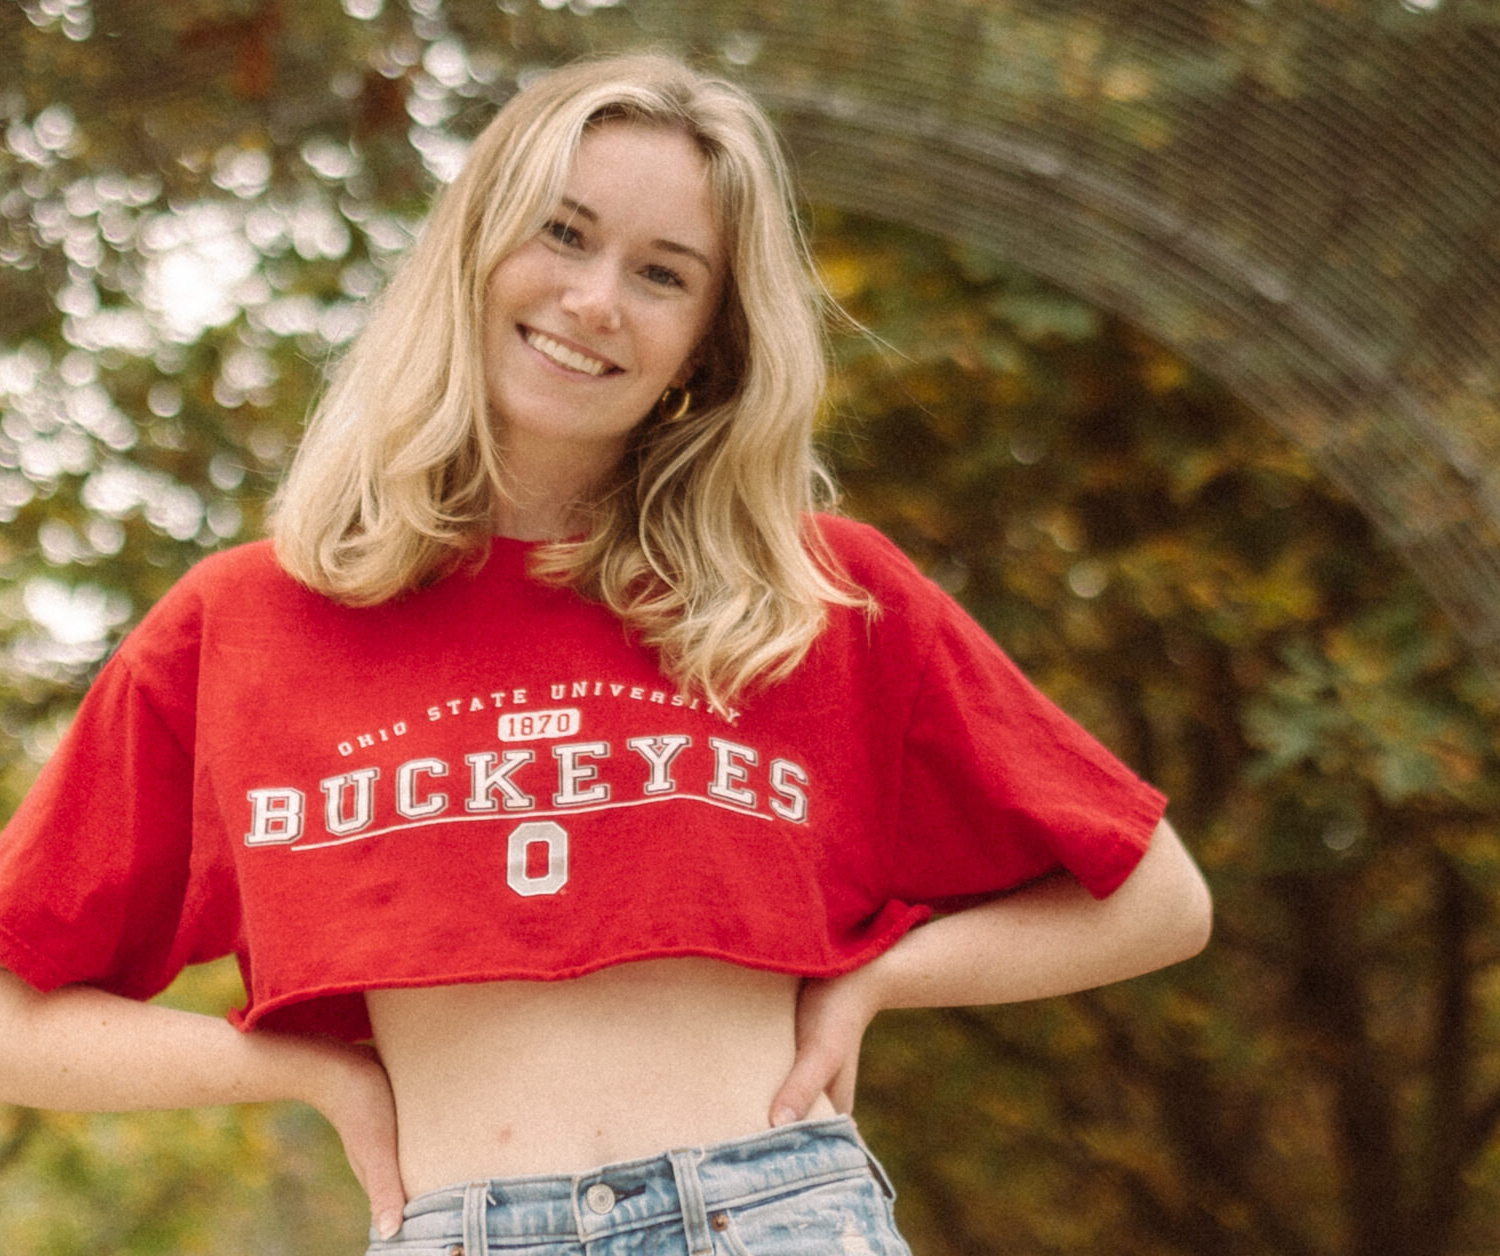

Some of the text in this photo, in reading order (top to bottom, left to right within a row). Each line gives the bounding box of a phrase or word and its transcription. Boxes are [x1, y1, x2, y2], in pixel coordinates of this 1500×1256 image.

[337, 721, 407, 757] OHIO
[427, 689, 527, 722] STATE
[506, 713, 572, 738] 1870
[244, 735, 808, 847] BUCKEYES
[507, 821, 569, 897] O
